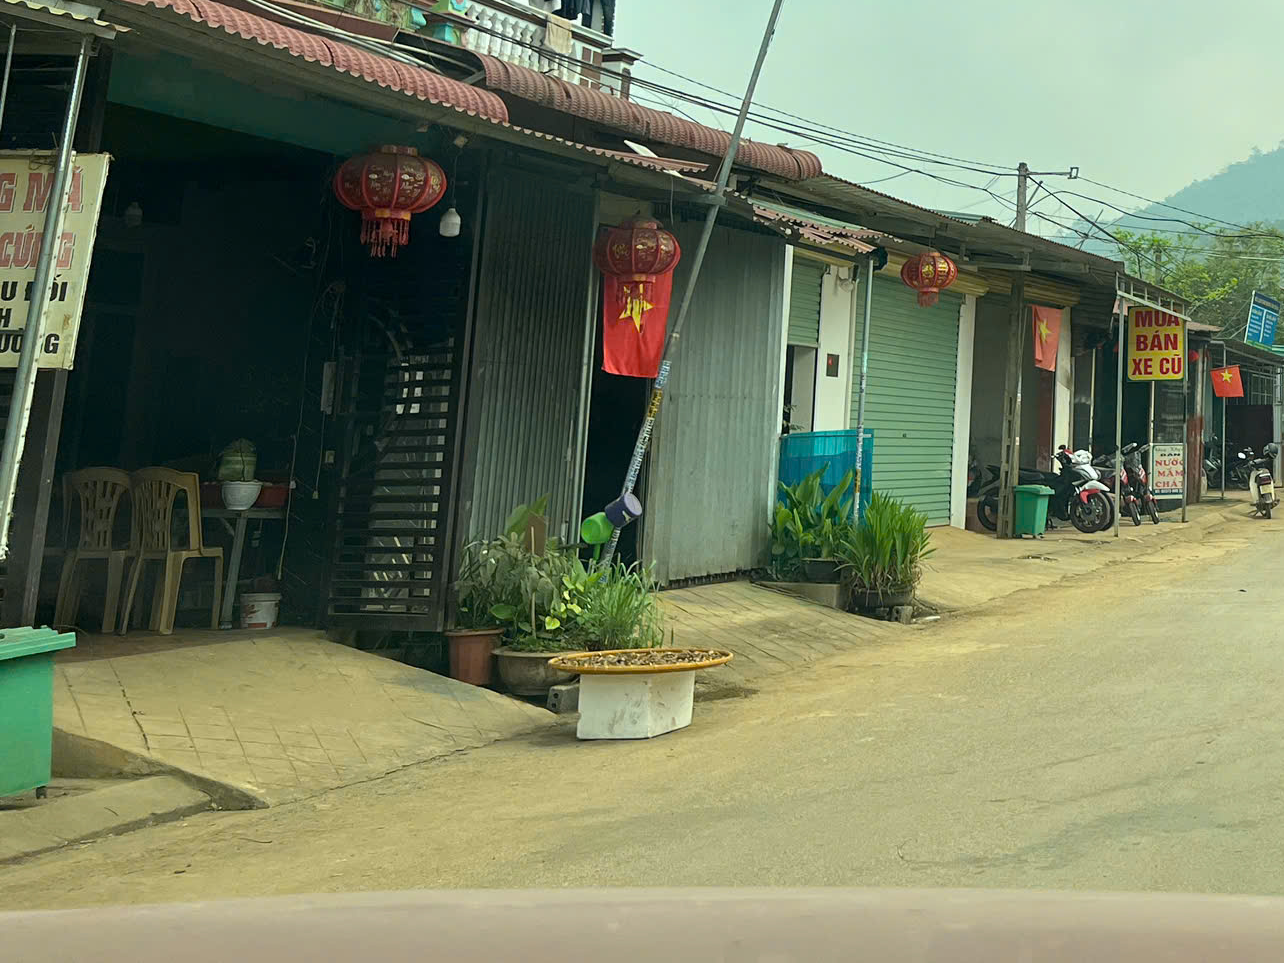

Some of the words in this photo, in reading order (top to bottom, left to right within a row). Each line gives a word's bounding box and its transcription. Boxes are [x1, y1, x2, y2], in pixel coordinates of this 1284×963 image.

[1135, 309, 1180, 327] MUA
[1136, 330, 1178, 351] BÁN
[1132, 358, 1153, 375] XE
[1160, 354, 1181, 375] CŨ
